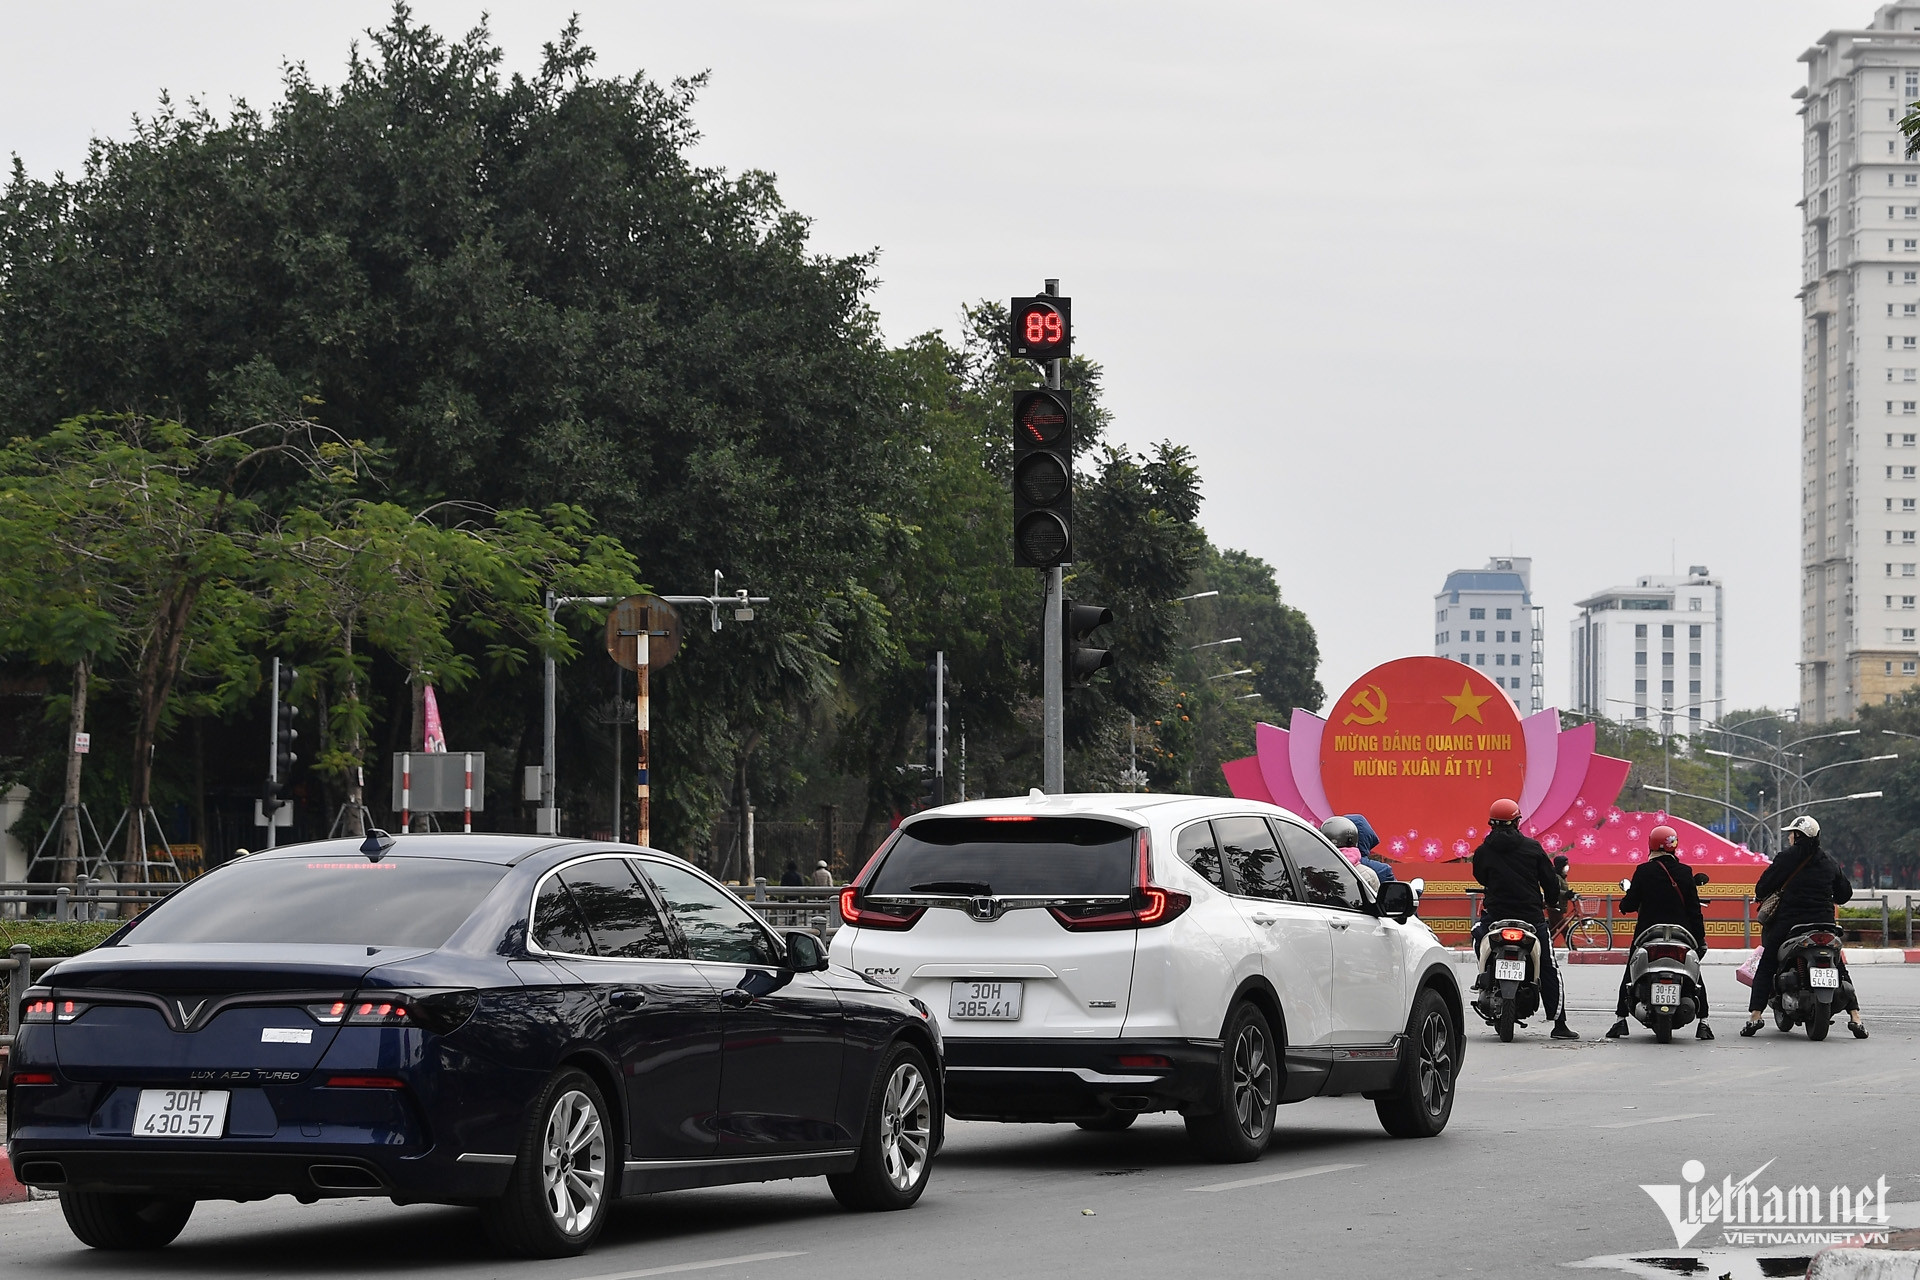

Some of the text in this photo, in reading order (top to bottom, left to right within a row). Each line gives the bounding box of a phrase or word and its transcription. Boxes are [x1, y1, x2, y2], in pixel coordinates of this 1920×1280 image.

[1027, 312, 1061, 342] 89
[1334, 730, 1512, 753] MỪNG ĐẢNG QUANG VINH
[1353, 757, 1397, 776] MỪNG
[1401, 756, 1441, 776] XUÂN
[1444, 754, 1463, 776] ẤT
[1466, 759, 1482, 779] TỴ
[864, 967, 900, 975] CR-V
[970, 983, 1001, 999] 30H
[1655, 985, 1677, 995] 30-F2
[1655, 995, 1677, 1004] 8505
[956, 1001, 1011, 1017] 385.41
[191, 1071, 216, 1080] LUX
[257, 1071, 300, 1080] TURBO
[163, 1091, 203, 1112] 30H
[143, 1113, 215, 1135] 430.57
